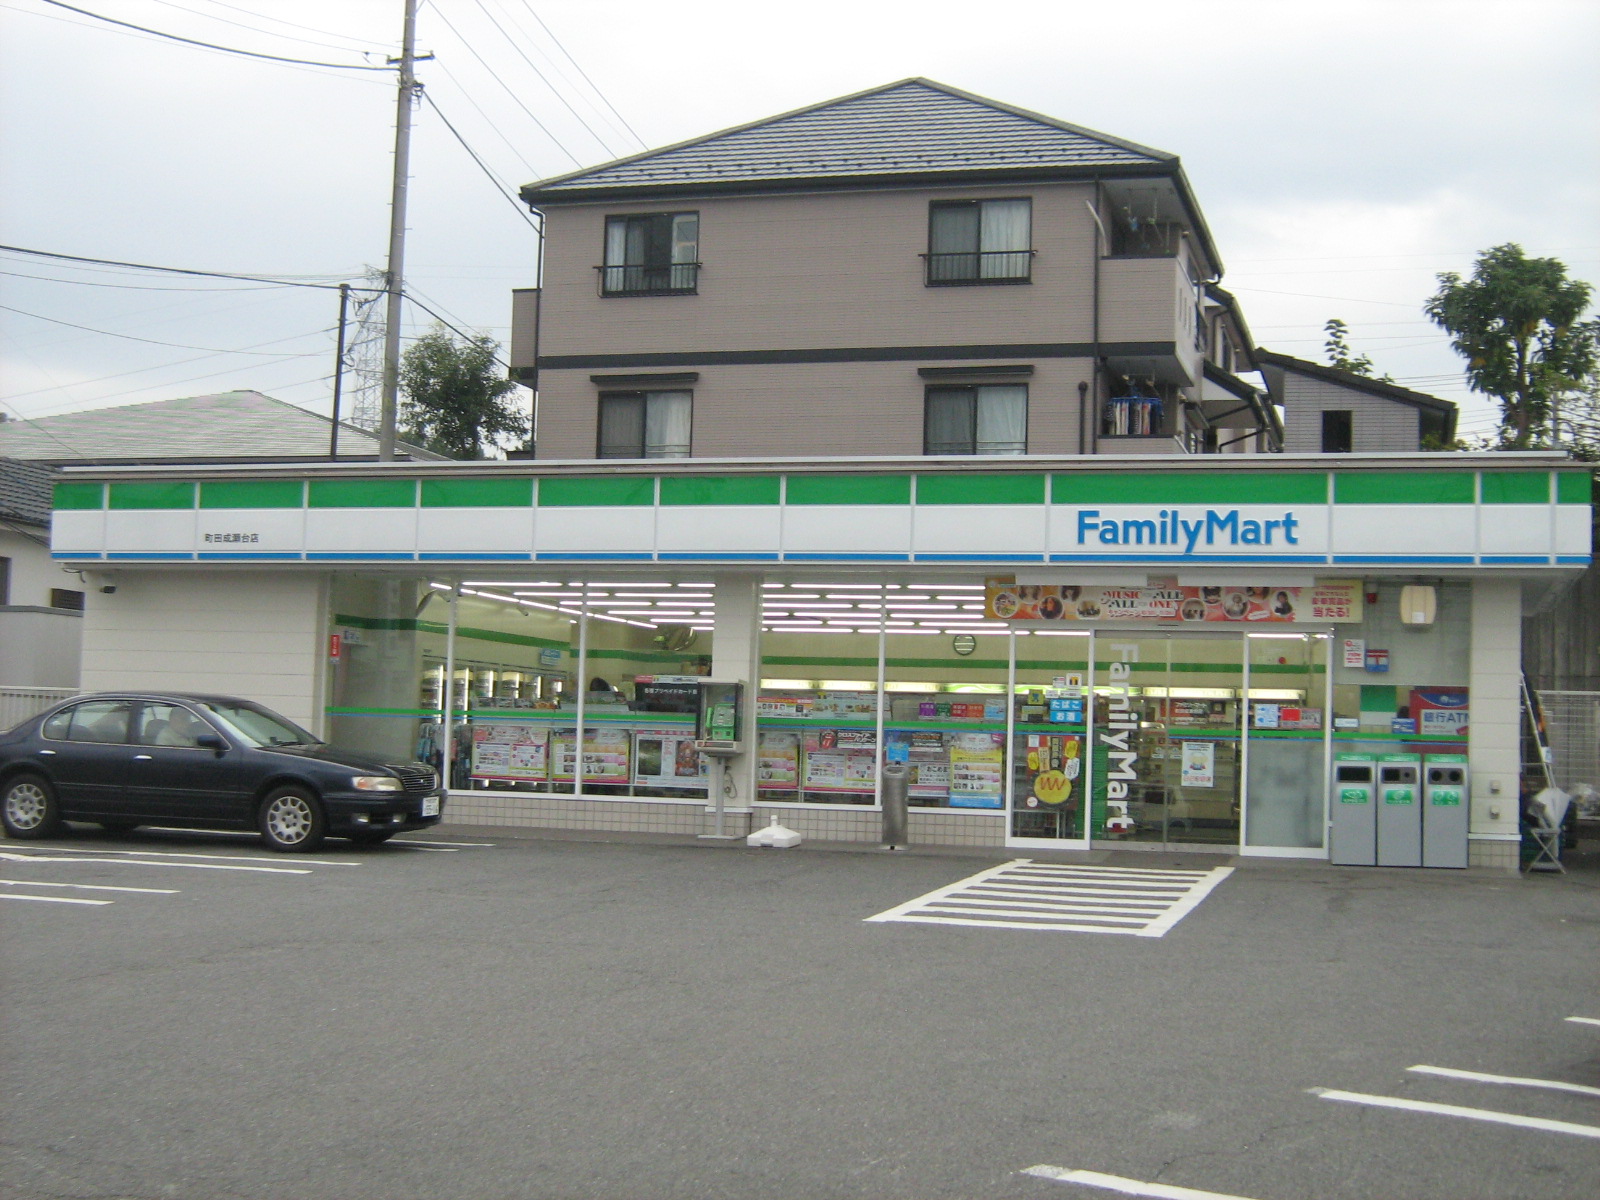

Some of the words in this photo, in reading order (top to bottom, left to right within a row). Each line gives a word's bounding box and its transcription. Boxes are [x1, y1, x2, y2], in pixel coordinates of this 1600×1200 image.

[1078, 510, 1298, 555] FamilyMart
[204, 533, 259, 543] 町田成瀬台店
[1104, 590, 1141, 599] MUSIC
[1153, 591, 1184, 599] ALL
[1109, 600, 1137, 608] ALL
[1149, 600, 1172, 609] ONE
[1051, 700, 1080, 709] たばこ
[1100, 643, 1139, 829] FamilyMart
